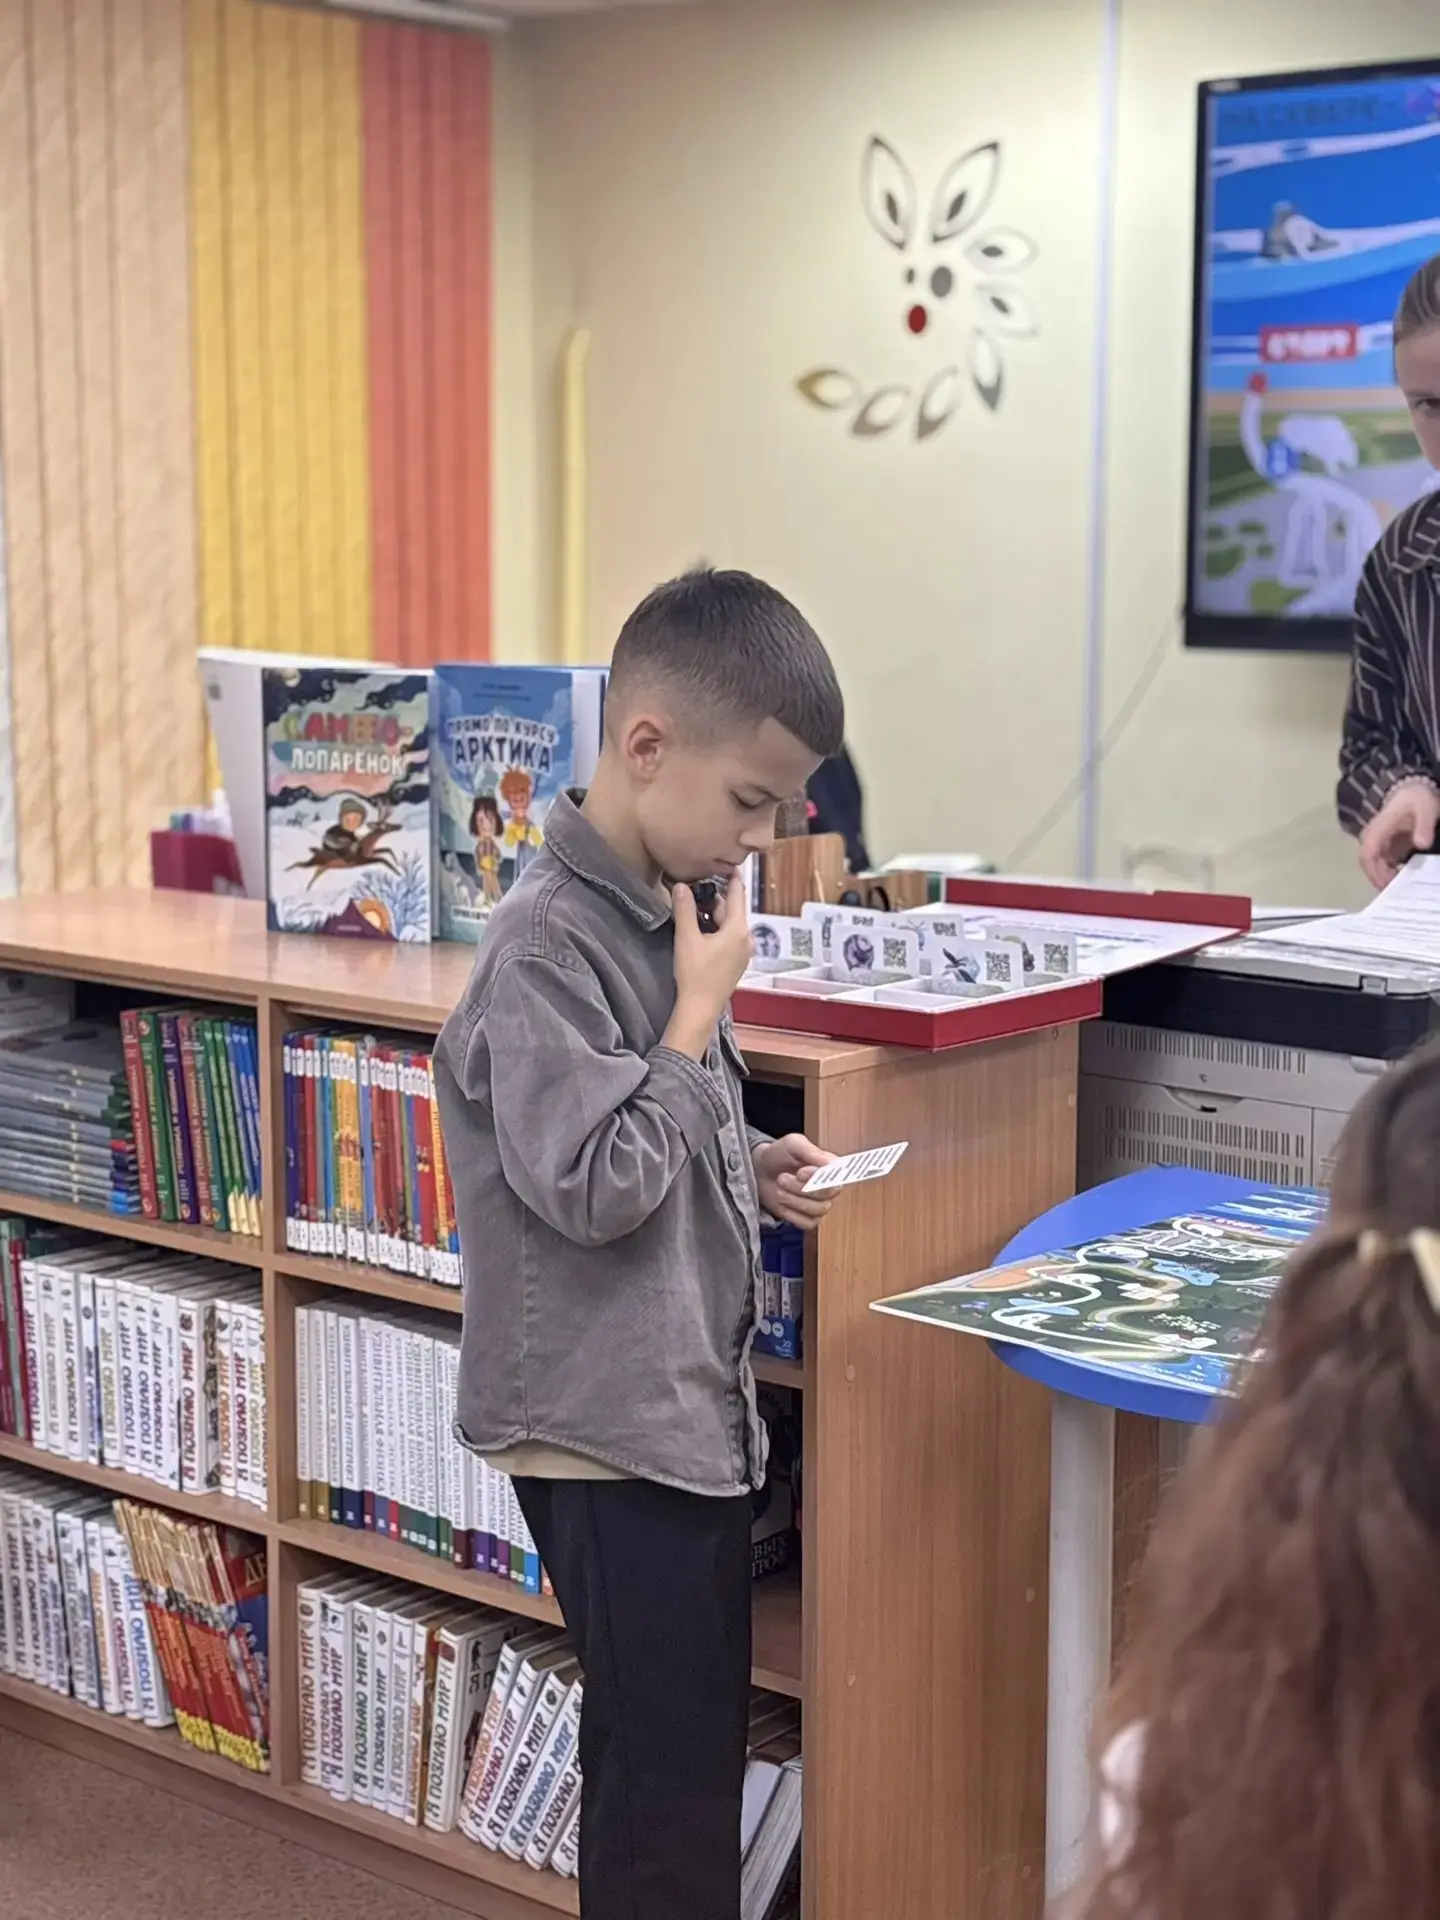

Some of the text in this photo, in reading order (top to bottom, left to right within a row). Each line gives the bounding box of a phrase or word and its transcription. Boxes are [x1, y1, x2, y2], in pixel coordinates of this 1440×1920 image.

[455, 737, 550, 773] АРКТИКА
[123, 1573, 142, 1611] МИР
[130, 1617, 152, 1690] ПОЗНАЮ
[330, 1647, 343, 1686] МИР
[356, 1642, 368, 1685] МИР
[376, 1667, 387, 1704] МИР
[355, 1690, 368, 1768] ПОЗНАЮ
[426, 1683, 451, 1818] Я ПОЗНАЮ МИР
[469, 1708, 518, 1827] Я ПОЗНАЮ МИР
[488, 1712, 547, 1837] Я ПОЗНАЮ МИР
[508, 1721, 574, 1847] Я ПОЗНАЮ МИР
[532, 1835, 546, 1853] Я
[539, 1772, 576, 1838] ПОЗНАЮ
[560, 1843, 573, 1861] Я
